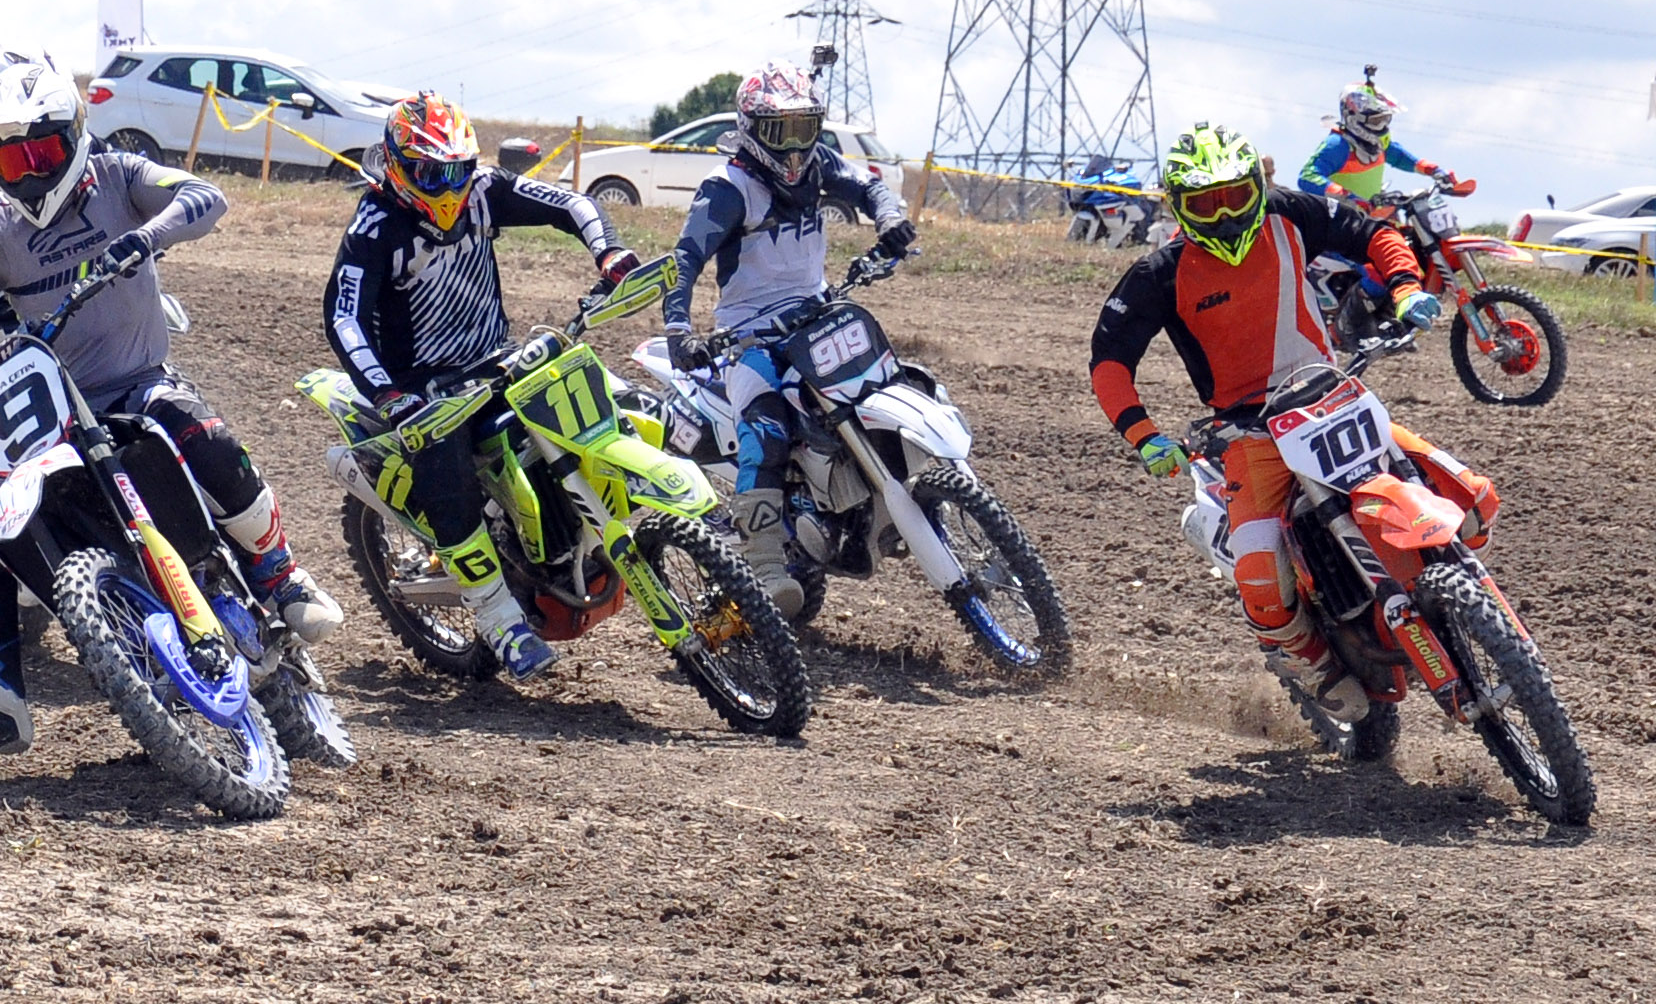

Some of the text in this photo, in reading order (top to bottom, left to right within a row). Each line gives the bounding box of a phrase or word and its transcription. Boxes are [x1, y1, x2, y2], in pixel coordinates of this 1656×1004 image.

[1195, 291, 1231, 313] KTM
[809, 319, 872, 378] 919
[545, 367, 601, 440] 11
[1309, 407, 1382, 479] 101
[376, 454, 414, 511] 11
[1346, 463, 1372, 483] KTM
[158, 554, 199, 620] PIRELLI
[1404, 623, 1447, 680] Putoline
